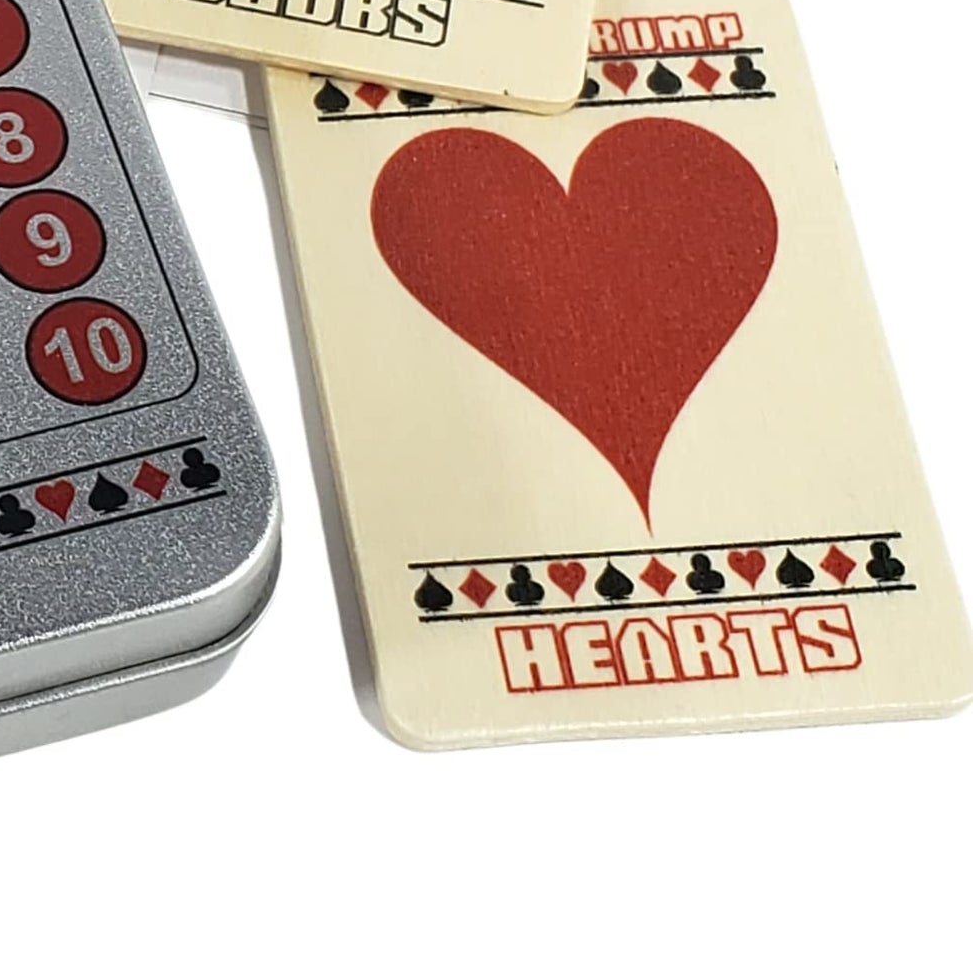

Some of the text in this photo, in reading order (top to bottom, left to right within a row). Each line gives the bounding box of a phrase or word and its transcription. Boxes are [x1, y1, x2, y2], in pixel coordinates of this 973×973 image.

[588, 12, 744, 55] RUMP
[26, 213, 72, 267] 9
[44, 317, 132, 382] 10
[493, 603, 863, 694] HEARTS
